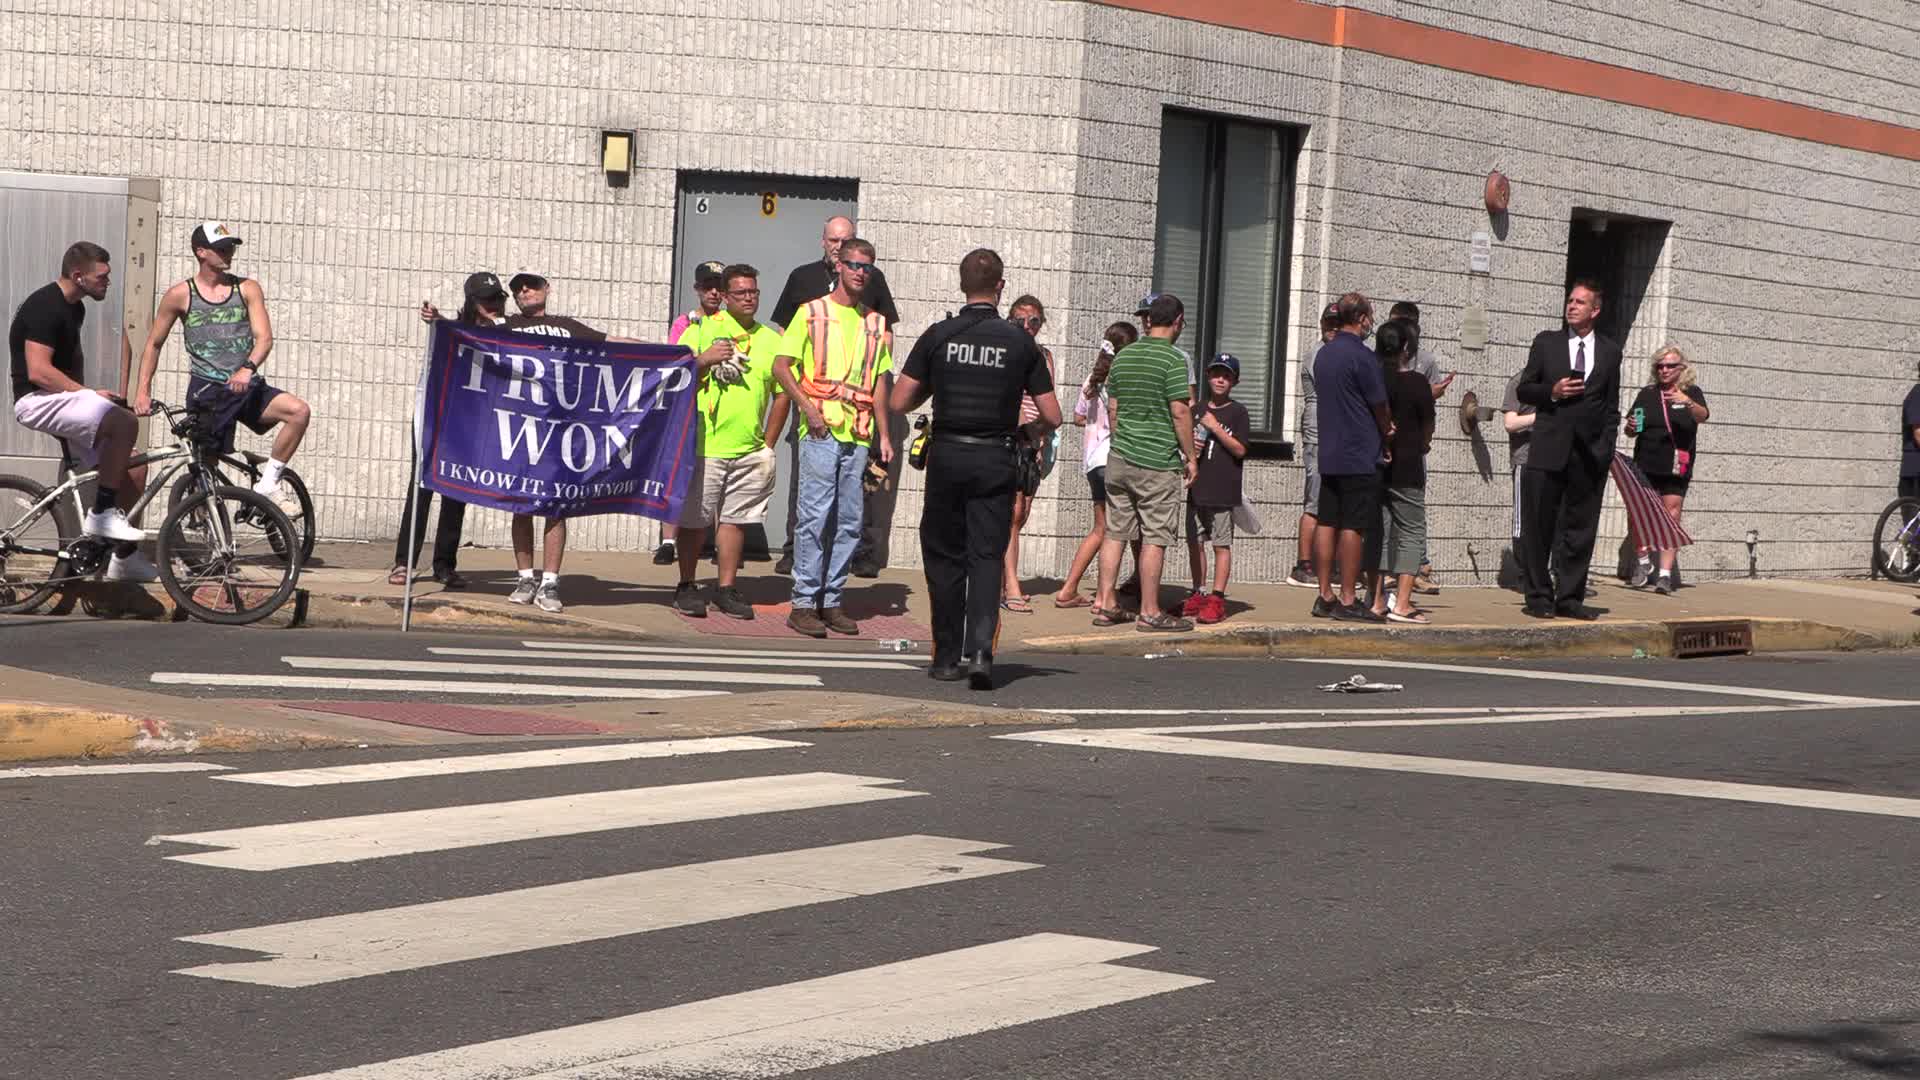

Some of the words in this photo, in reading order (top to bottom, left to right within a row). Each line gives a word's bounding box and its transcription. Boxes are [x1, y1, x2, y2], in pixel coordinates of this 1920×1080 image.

[697, 199, 707, 213] 6
[762, 192, 774, 215] 6
[512, 325, 571, 338] RUMP
[947, 342, 1007, 368] POLICE
[458, 344, 692, 412] TRUMP
[493, 408, 640, 472] WON
[439, 460, 446, 476] I
[450, 464, 517, 490] KNOW
[520, 477, 546, 496] IT.
[553, 482, 589, 499] YOU
[642, 479, 664, 497] IT
